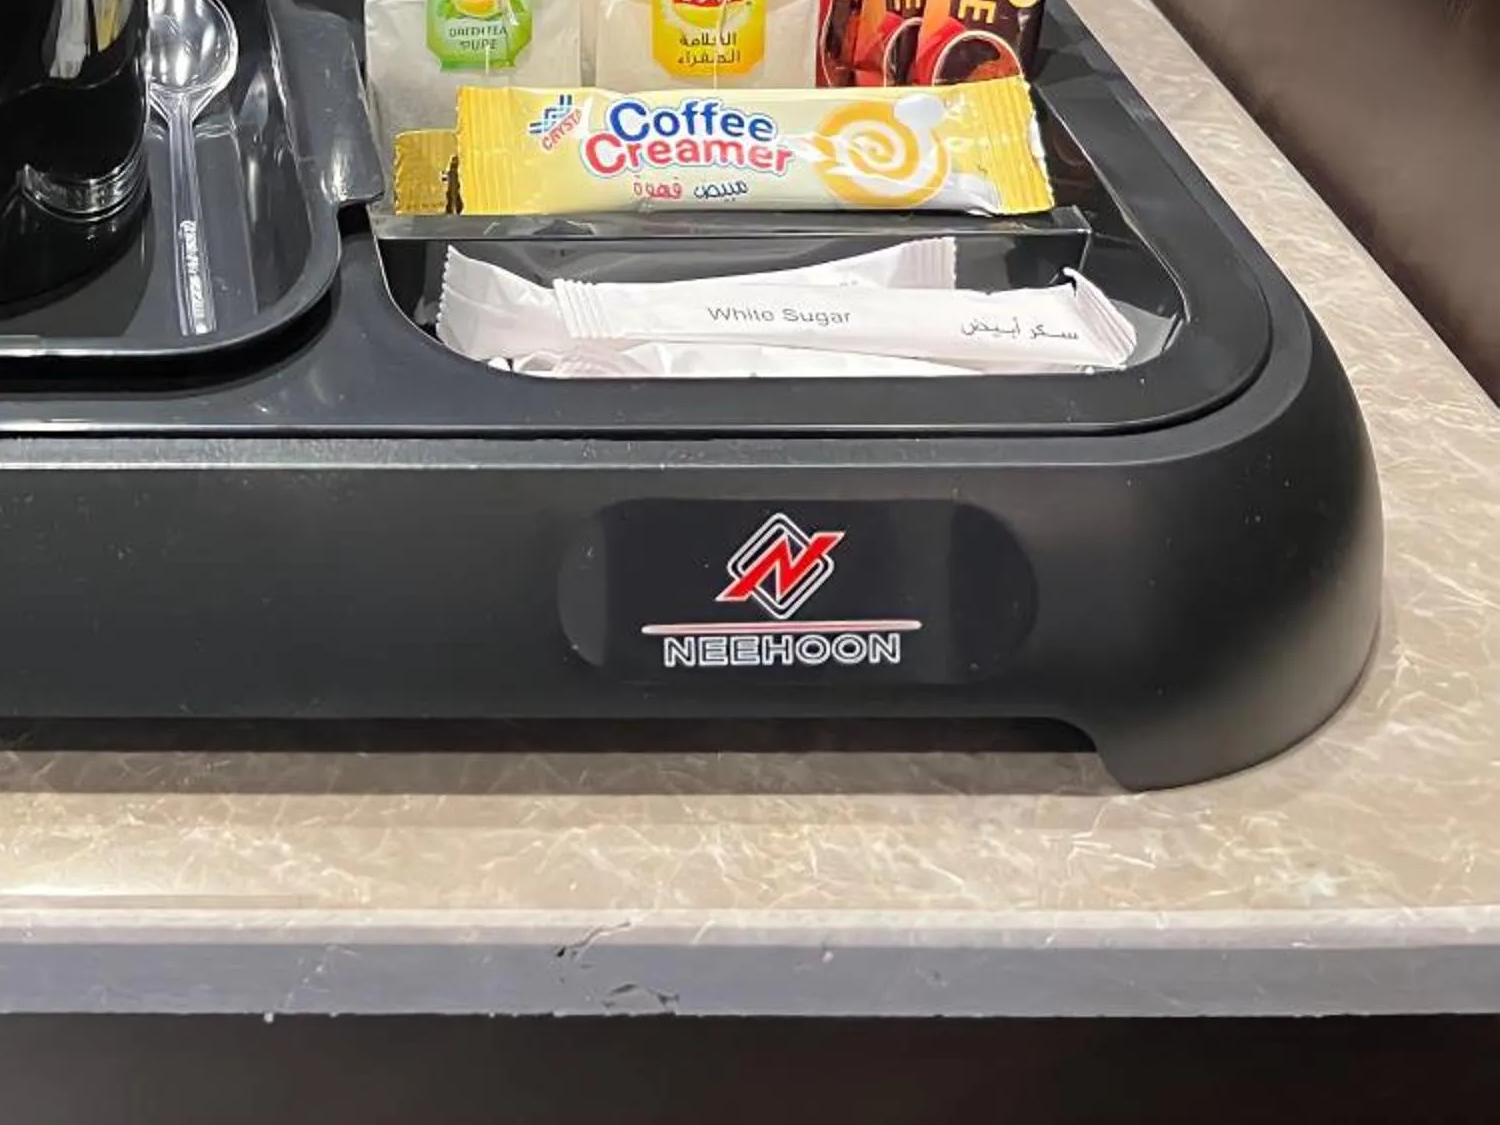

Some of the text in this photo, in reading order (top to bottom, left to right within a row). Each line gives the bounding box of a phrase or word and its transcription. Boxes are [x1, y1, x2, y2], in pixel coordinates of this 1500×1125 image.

[679, 32, 737, 47] اللامة
[609, 99, 775, 143] Coffee
[584, 132, 793, 174] Creamer
[633, 175, 684, 200] قهوة
[707, 306, 851, 327] White Sugar
[960, 316, 1080, 340] سكر أبيض
[663, 632, 901, 668] NEEHOON
